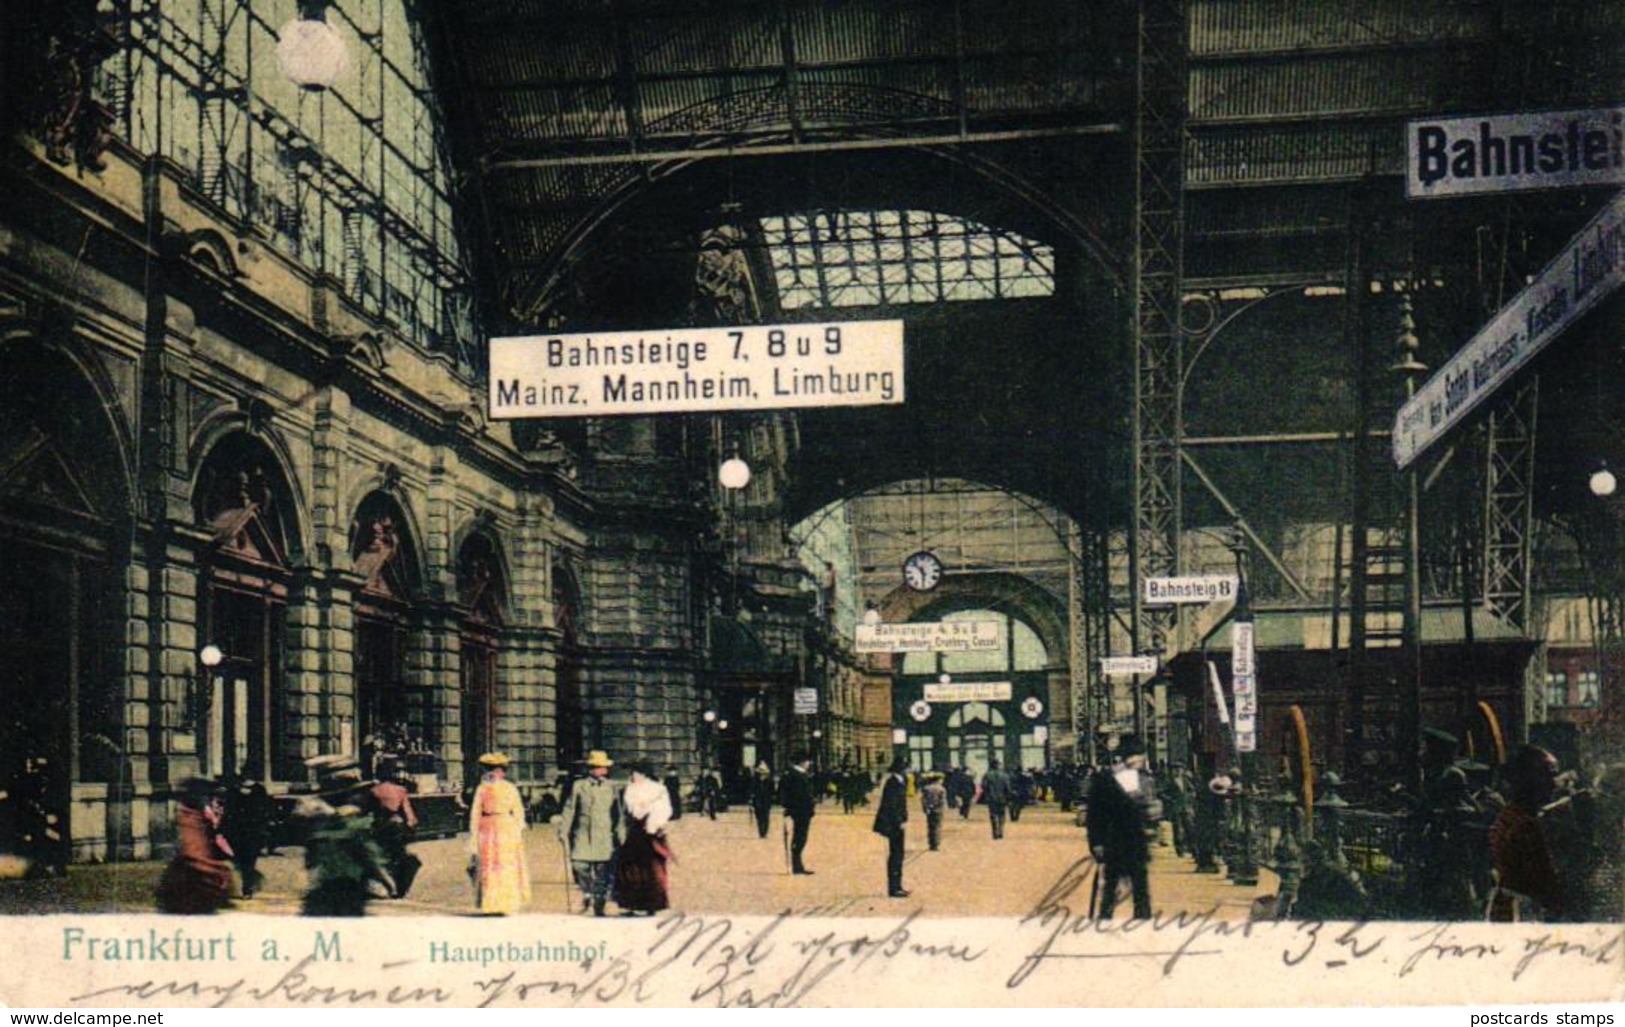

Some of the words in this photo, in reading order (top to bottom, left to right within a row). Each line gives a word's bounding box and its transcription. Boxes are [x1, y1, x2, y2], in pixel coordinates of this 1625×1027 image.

[547, 337, 707, 369] Bahnsteige
[768, 330, 786, 357] 8
[798, 336, 811, 355] u
[825, 327, 841, 354] 9
[773, 366, 894, 400] Limburg
[1150, 582, 1216, 599] Bahnsteig
[1219, 580, 1230, 595] 8
[62, 927, 236, 961] Frankfurt
[261, 940, 290, 961] a.
[312, 930, 354, 962] M.
[429, 940, 614, 964] Hauptbahnhof.
